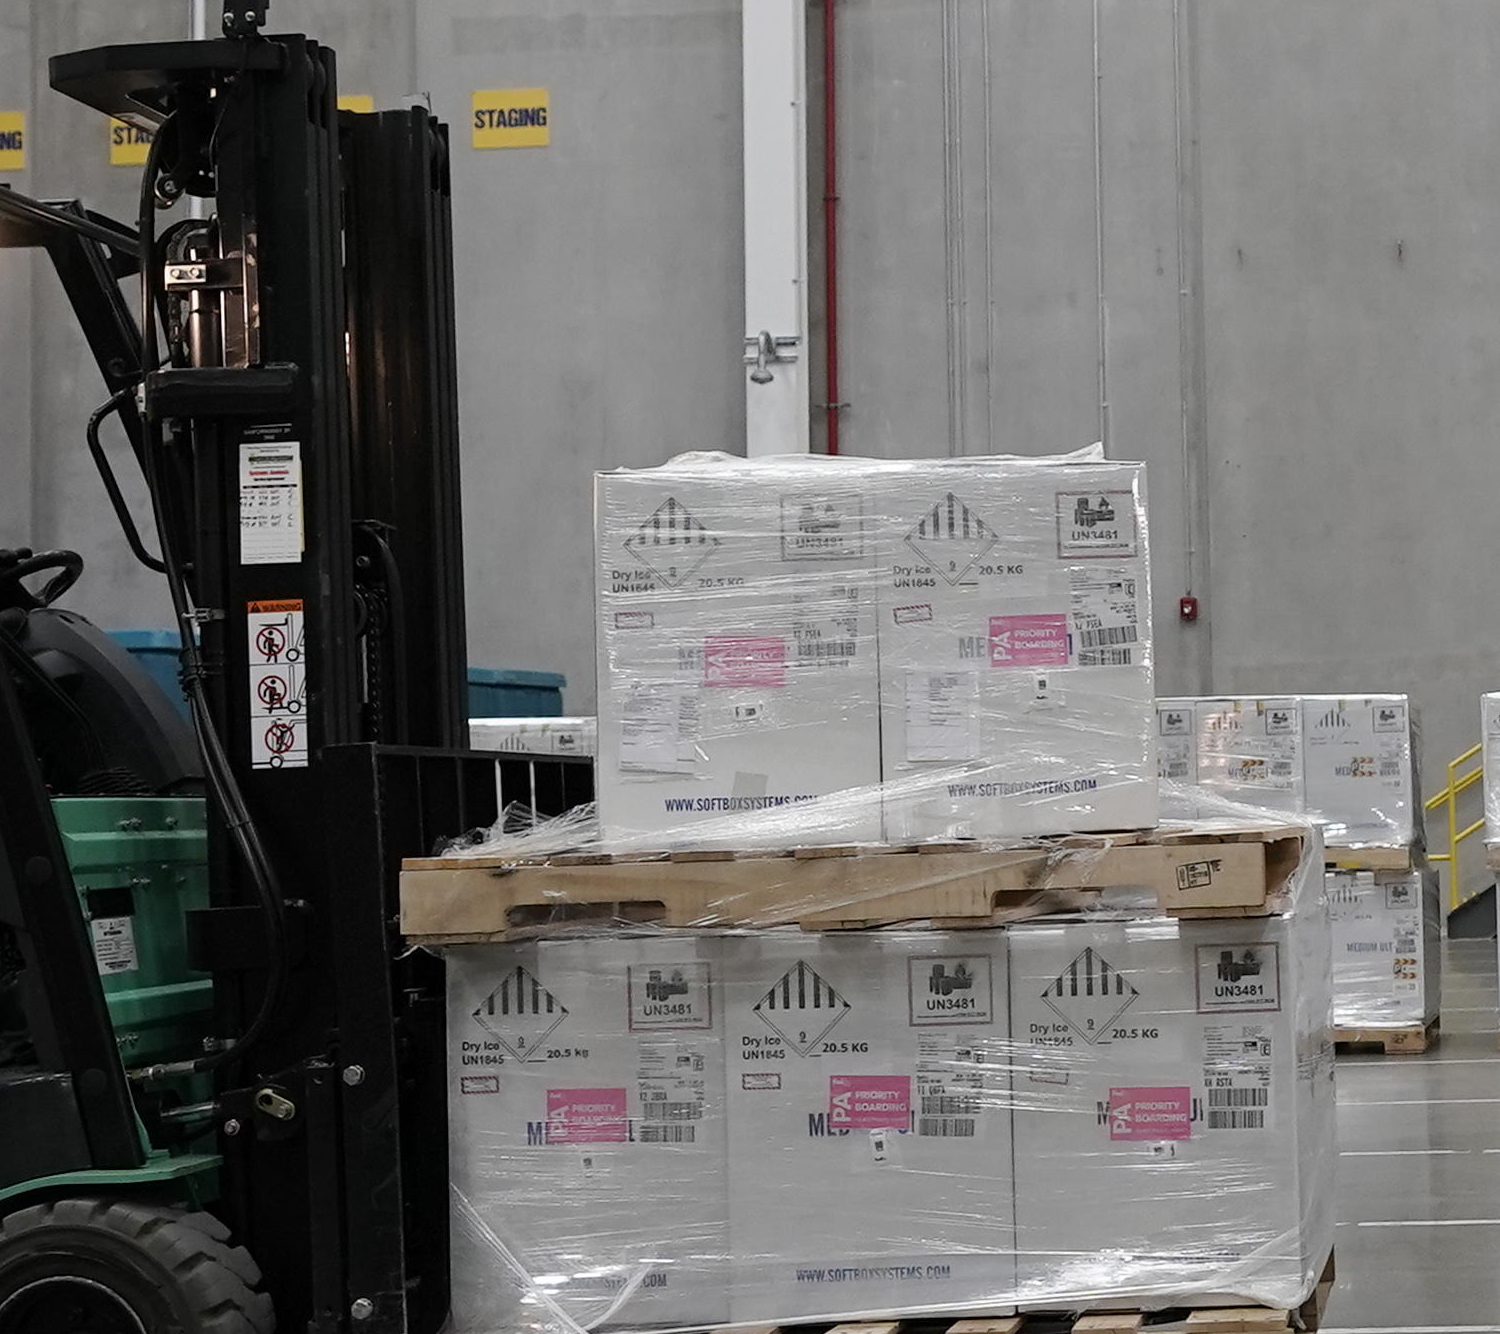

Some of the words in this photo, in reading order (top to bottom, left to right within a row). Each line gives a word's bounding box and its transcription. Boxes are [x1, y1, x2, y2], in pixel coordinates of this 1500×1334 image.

[474, 107, 547, 131] STAGING
[1215, 985, 1264, 996] UN3481
[644, 1004, 692, 1015] UN3481
[927, 999, 975, 1010] UN3481
[743, 1036, 761, 1047] Dry
[765, 1036, 781, 1046] Ice
[822, 1042, 847, 1053] 20.5
[851, 1042, 868, 1052] KG
[743, 1049, 785, 1060] UN1845
[855, 1091, 900, 1100] PRIORITY
[832, 1092, 851, 1122] PA
[855, 1102, 906, 1112] BOARDING
[796, 1266, 950, 1282] WWW.SOFTBOXSYSTEMS.COM
